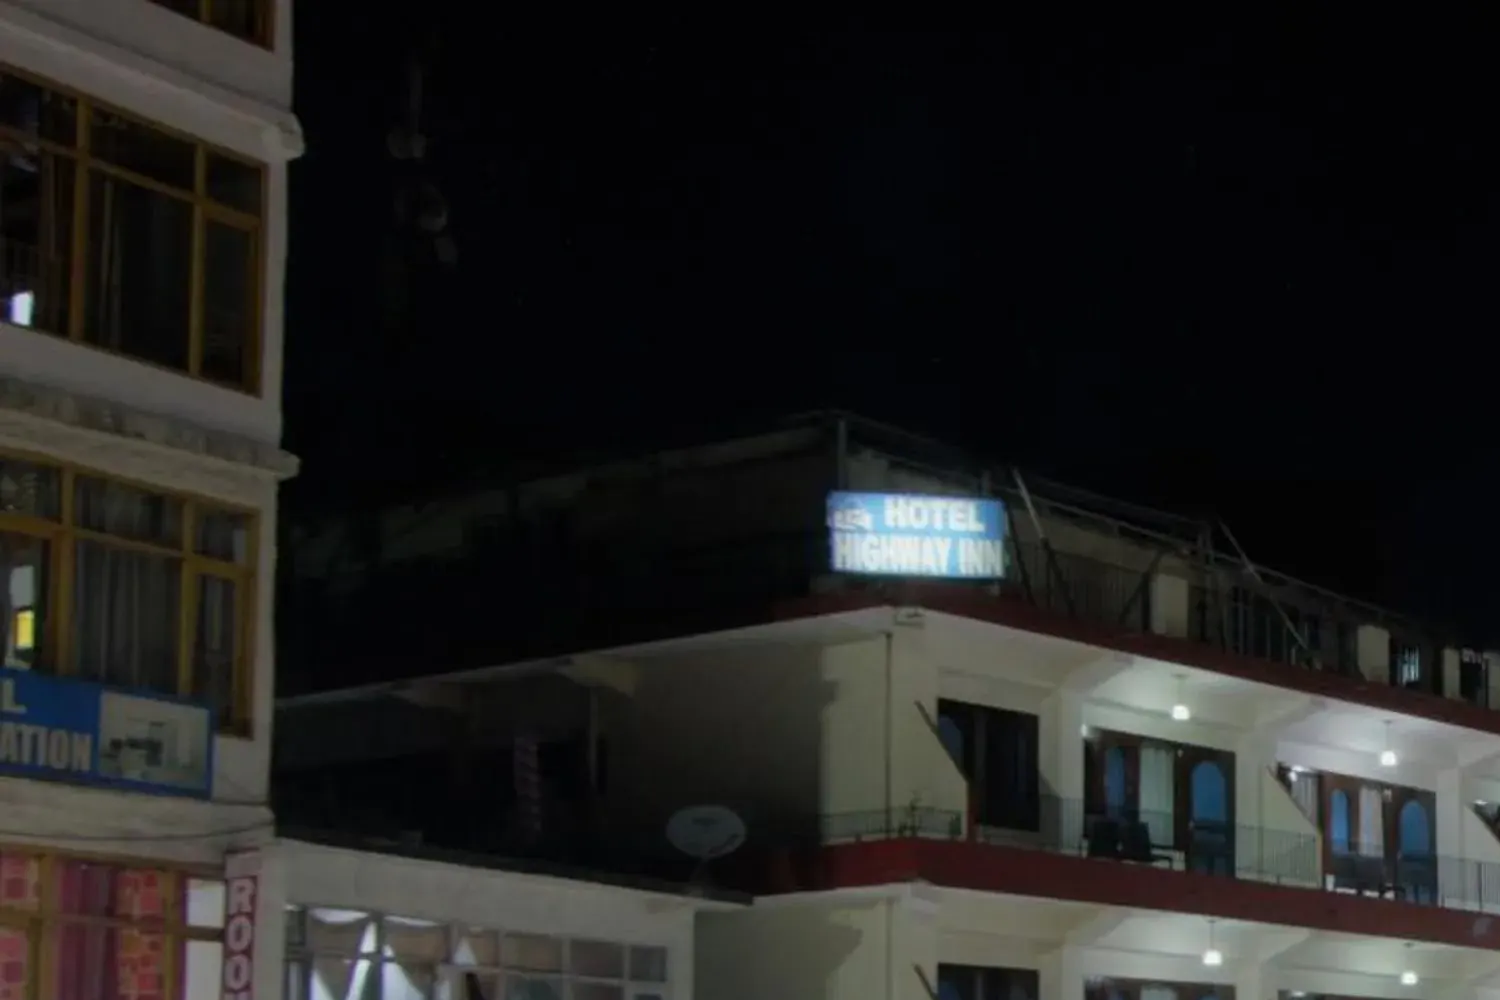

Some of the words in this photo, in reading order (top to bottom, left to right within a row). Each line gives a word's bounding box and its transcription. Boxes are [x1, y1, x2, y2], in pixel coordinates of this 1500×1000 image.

[884, 495, 985, 532] HOTEL
[833, 532, 950, 576] HIGHWAY
[958, 537, 1003, 577] INN
